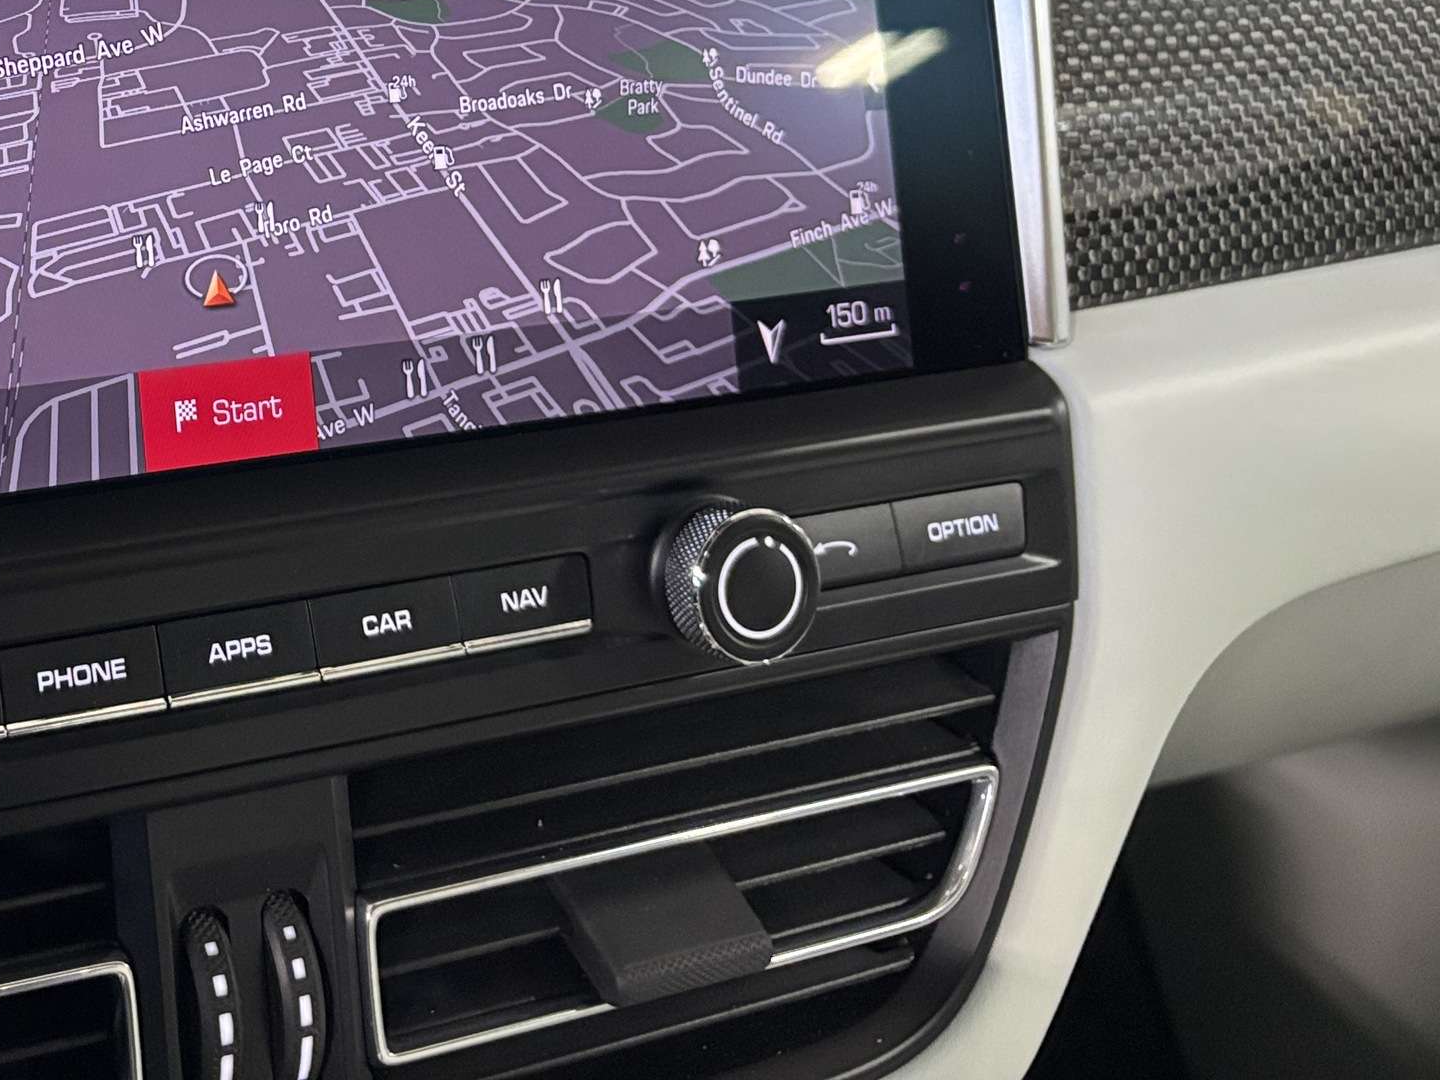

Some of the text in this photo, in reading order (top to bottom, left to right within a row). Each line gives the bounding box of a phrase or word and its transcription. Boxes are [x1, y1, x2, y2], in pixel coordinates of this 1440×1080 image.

[94, 37, 135, 61] Ave
[141, 23, 165, 46] W
[392, 74, 417, 88] 24h
[620, 79, 664, 98] Bratty
[735, 65, 817, 89] Dundee Dr
[181, 92, 308, 135] Ashwarren Rd
[459, 83, 573, 116] Broadoaks Dr
[627, 98, 660, 116] Park
[709, 66, 784, 145] Sentinel Rd
[209, 144, 314, 187] Le Page Ct
[445, 170, 466, 197] St
[308, 203, 334, 226] Rd
[790, 197, 893, 249] Finch Ave W
[826, 300, 893, 329] 150 m
[212, 394, 284, 427] Start
[353, 402, 375, 427] W
[927, 512, 1000, 544] OPTION
[500, 585, 549, 613] NAV
[361, 608, 412, 638] CAR
[208, 633, 273, 666] APPS
[36, 657, 127, 695] PHONE
